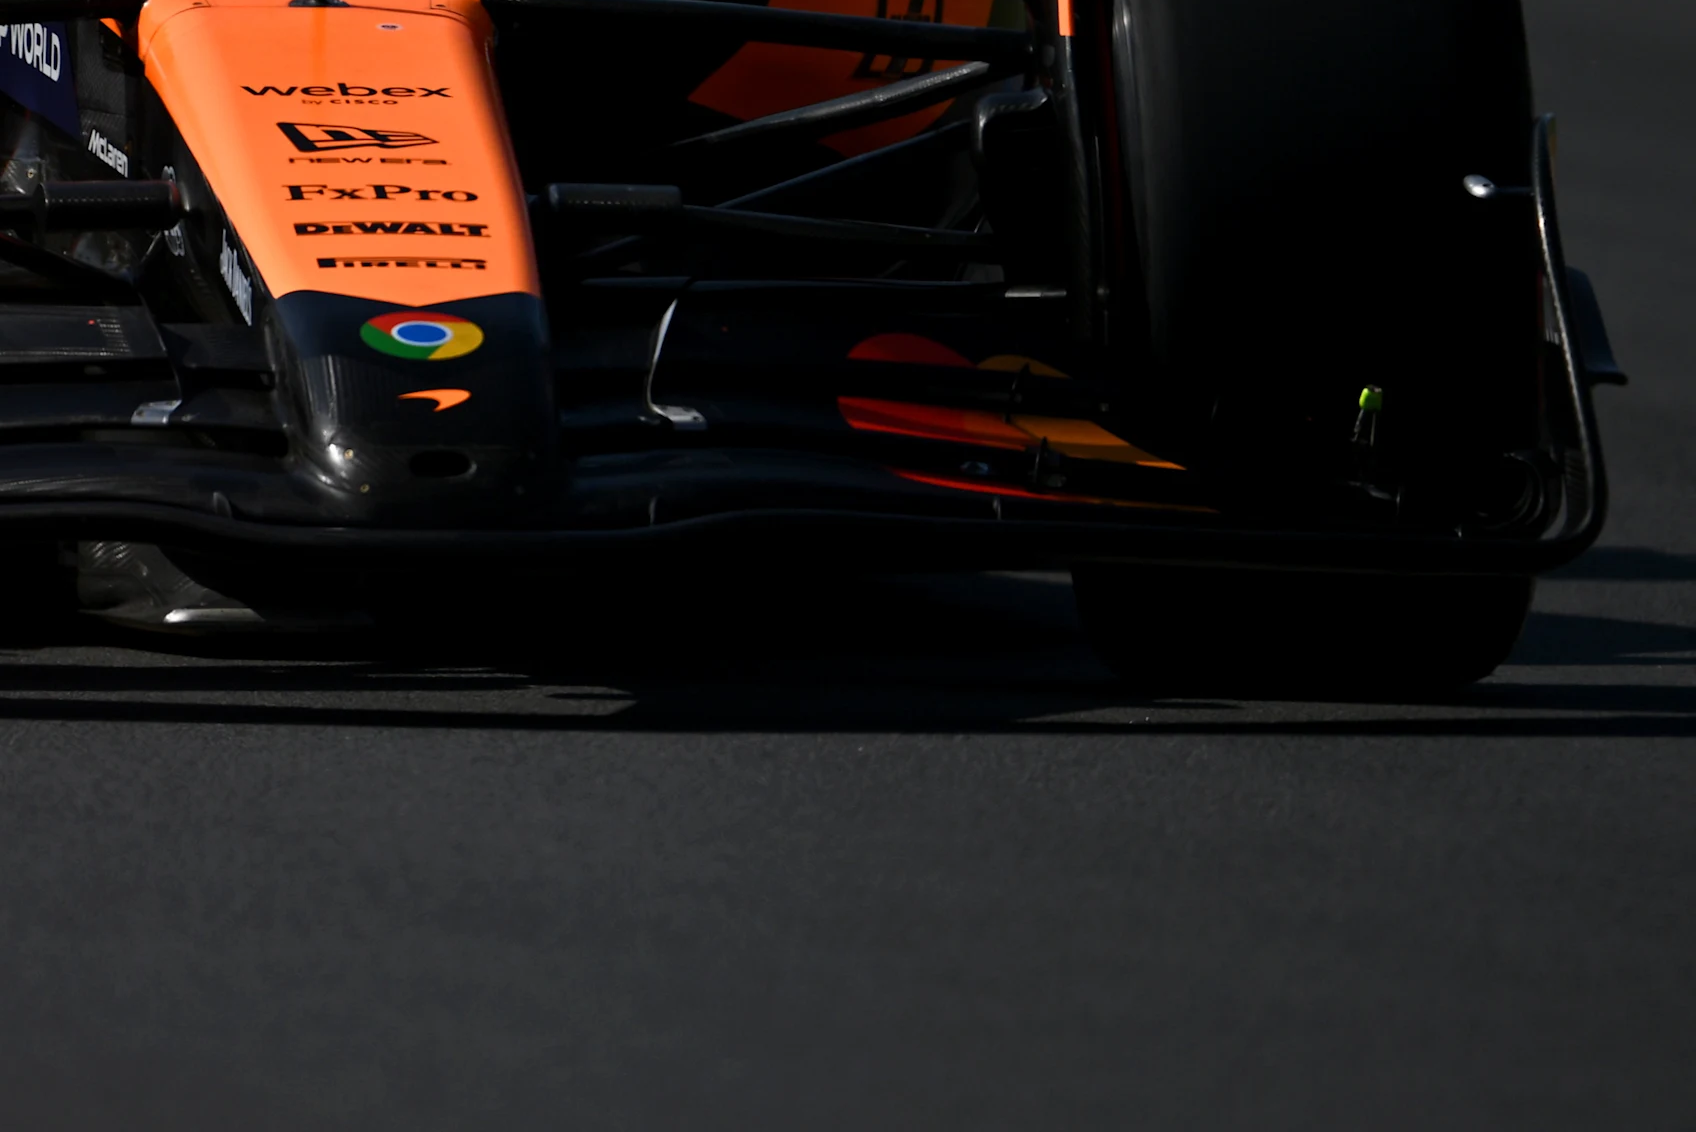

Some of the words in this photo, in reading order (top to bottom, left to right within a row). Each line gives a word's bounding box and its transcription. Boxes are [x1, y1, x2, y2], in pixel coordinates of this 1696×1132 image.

[10, 22, 62, 82] WORLD
[241, 83, 453, 98] webex
[88, 128, 129, 179] McLaren
[281, 184, 479, 202] FxPro
